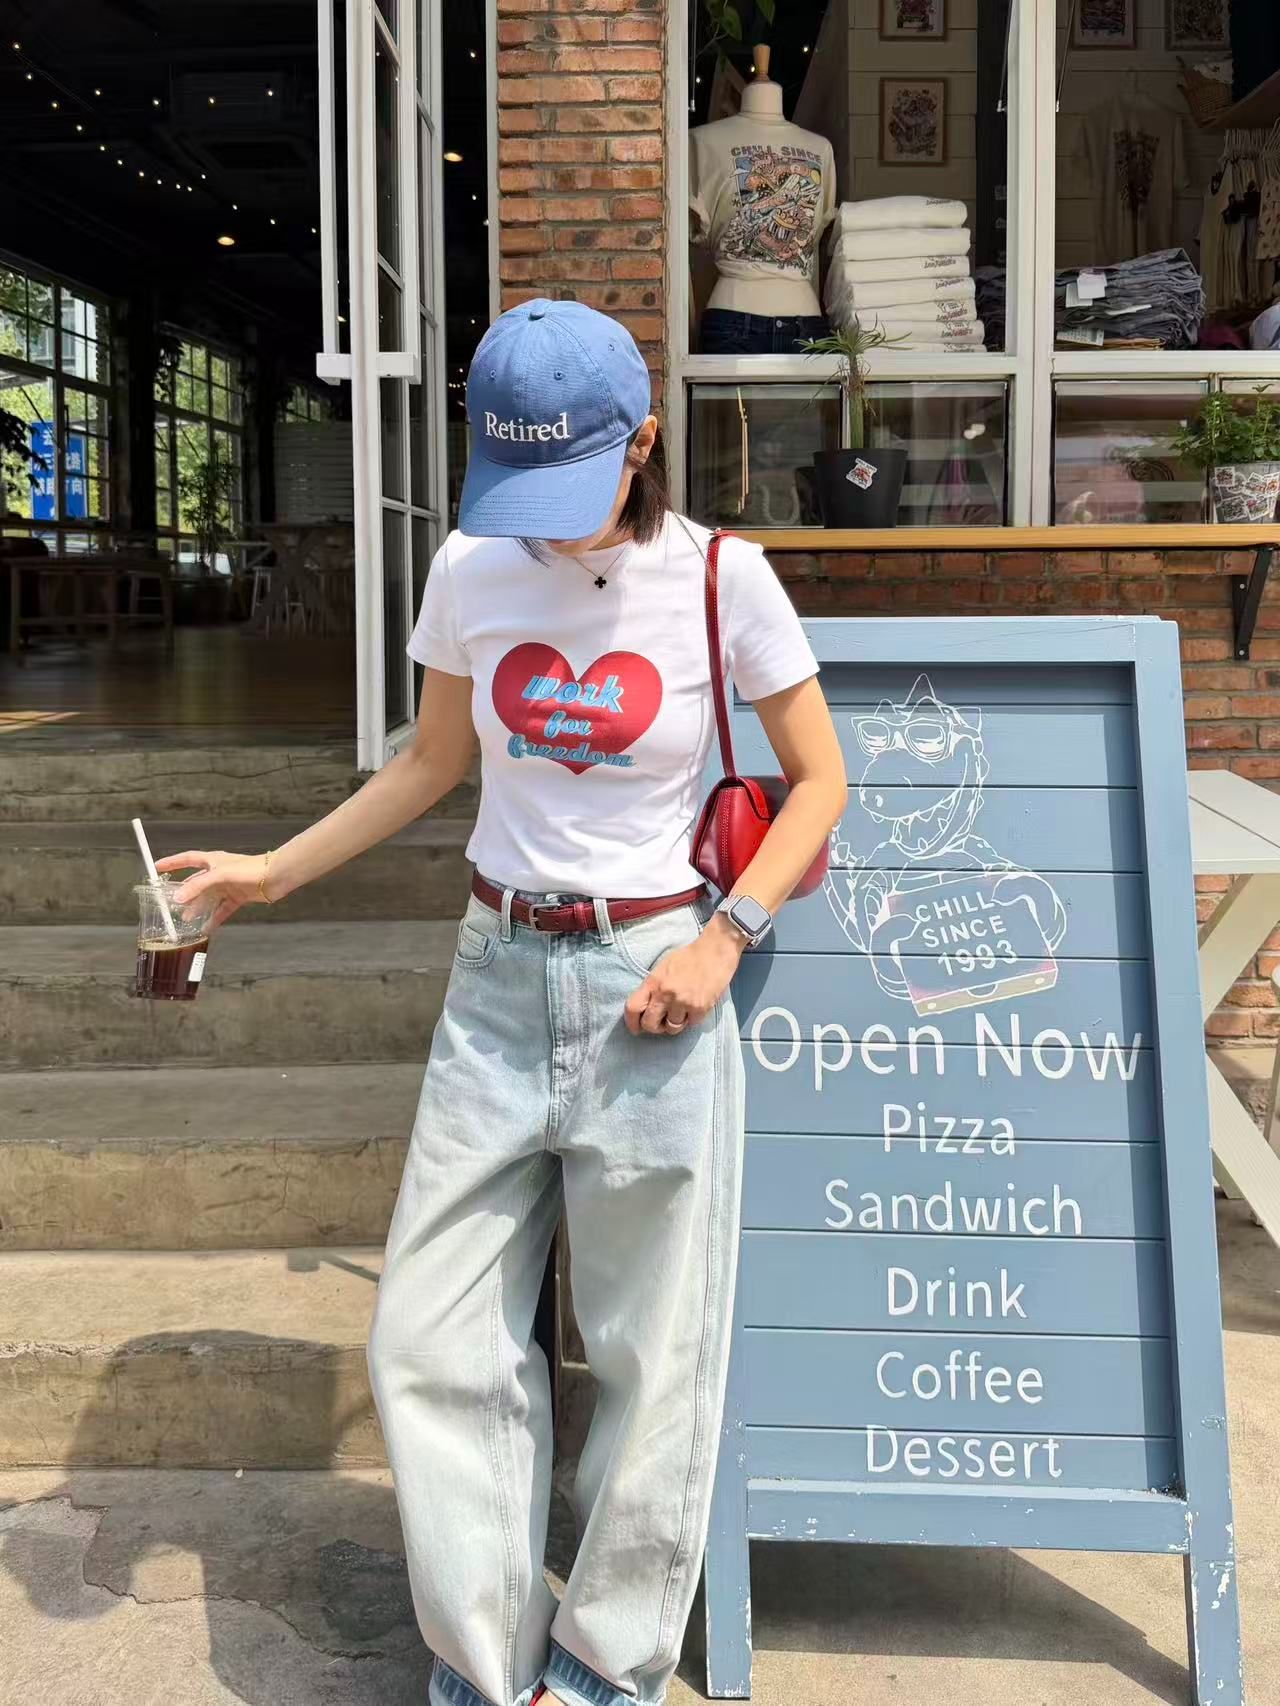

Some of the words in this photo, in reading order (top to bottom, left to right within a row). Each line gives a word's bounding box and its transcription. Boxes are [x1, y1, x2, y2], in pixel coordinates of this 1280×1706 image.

[484, 411, 571, 442] Retired
[544, 710, 594, 739] for
[507, 733, 637, 768] freedom
[915, 891, 996, 923] CHILL
[922, 914, 1008, 948] SINCE
[937, 939, 1018, 976] 1993
[750, 1006, 945, 1091] Open
[974, 1012, 1143, 1081] Now
[882, 1102, 1016, 1156] Pizza
[824, 1178, 1083, 1236] Sandwich
[887, 1266, 1030, 1319] Drink
[875, 1349, 1044, 1404] Coffee
[865, 1424, 1064, 1480] Dessert
